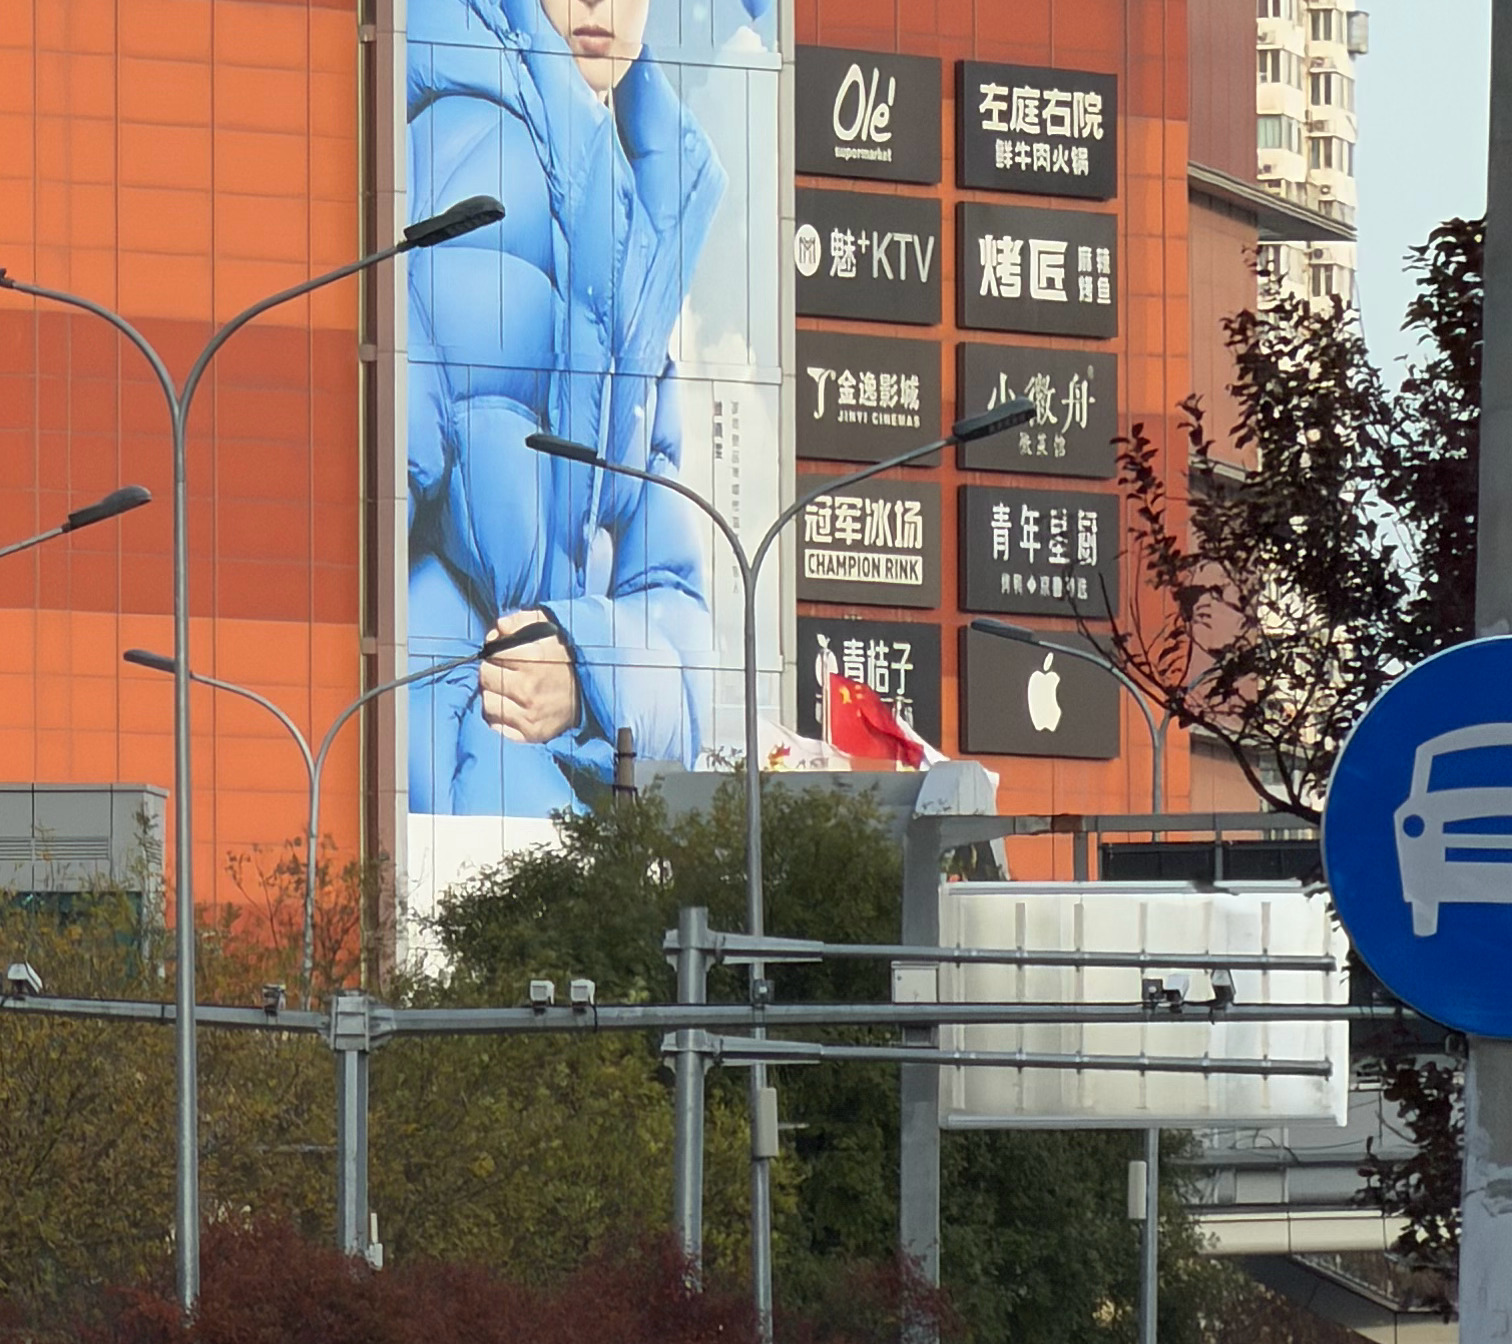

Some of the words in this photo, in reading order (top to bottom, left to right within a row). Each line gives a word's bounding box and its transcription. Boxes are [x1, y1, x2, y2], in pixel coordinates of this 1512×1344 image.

[979, 82, 1104, 140] 左庭右院
[995, 138, 1089, 176] 鲜牛肉火锅
[978, 234, 1068, 301] 烤匠
[837, 369, 920, 411] 金逸影城
[804, 495, 923, 549] 冠军冰场
[808, 553, 881, 578] CHAMPION
[885, 558, 919, 581] RINK
[842, 638, 914, 695] 青桔子
